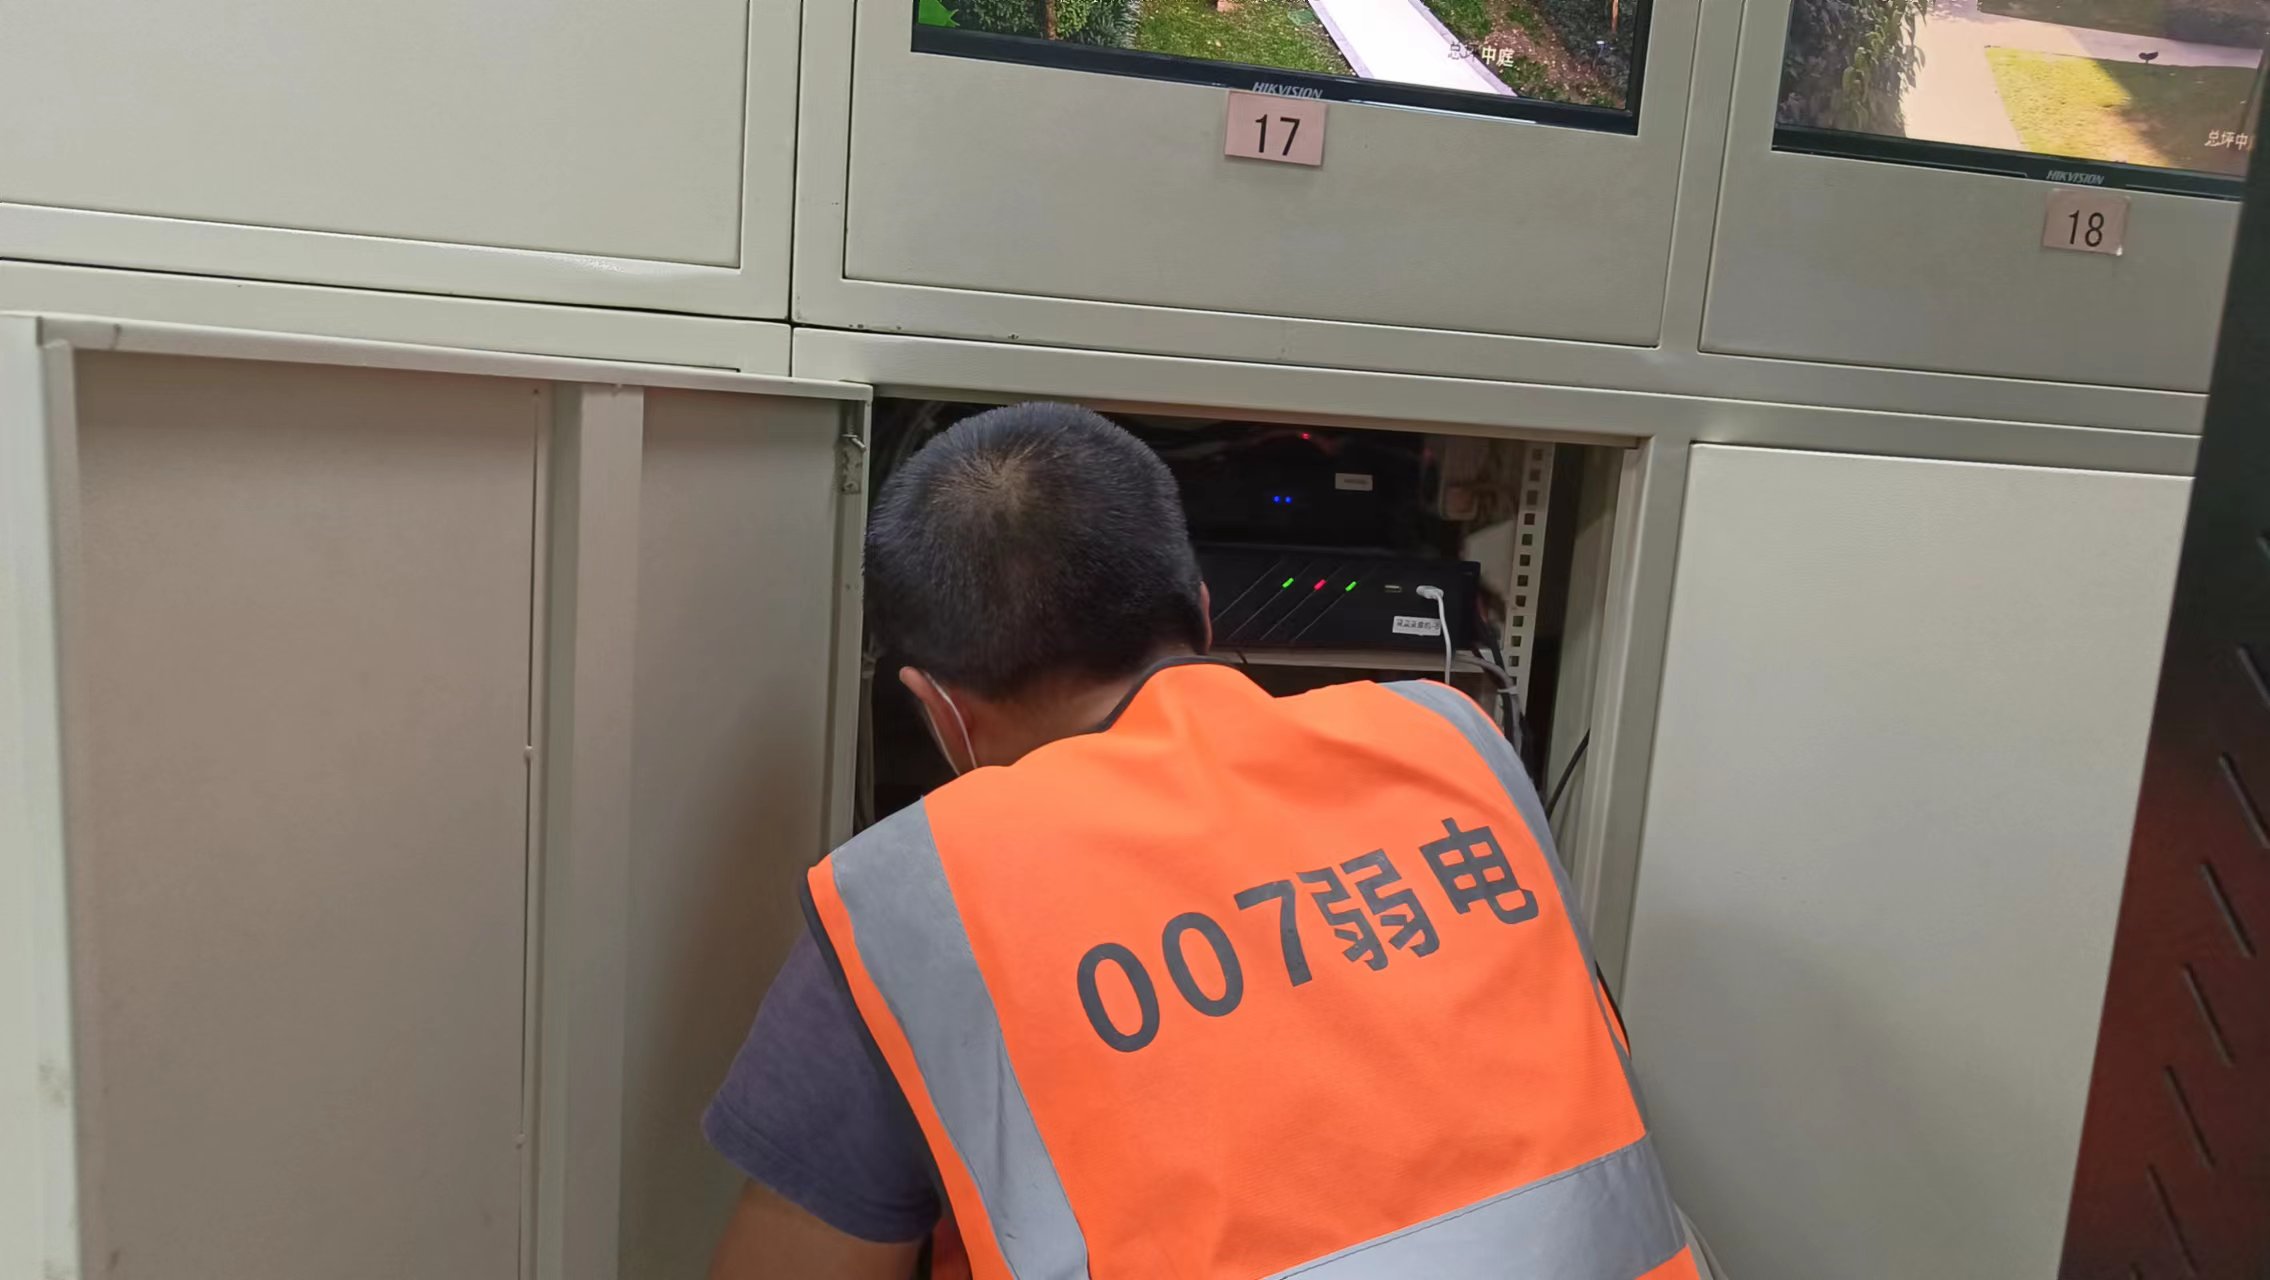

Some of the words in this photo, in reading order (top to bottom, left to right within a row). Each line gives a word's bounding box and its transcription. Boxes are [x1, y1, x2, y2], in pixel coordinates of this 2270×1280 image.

[1252, 81, 1323, 98] HIKVISION
[1255, 114, 1301, 156] 17
[2204, 130, 2252, 150] 总坪中
[2046, 170, 2104, 184] HIKVISION
[2068, 209, 2104, 247] 18
[1077, 817, 1539, 1053] 007弱电
